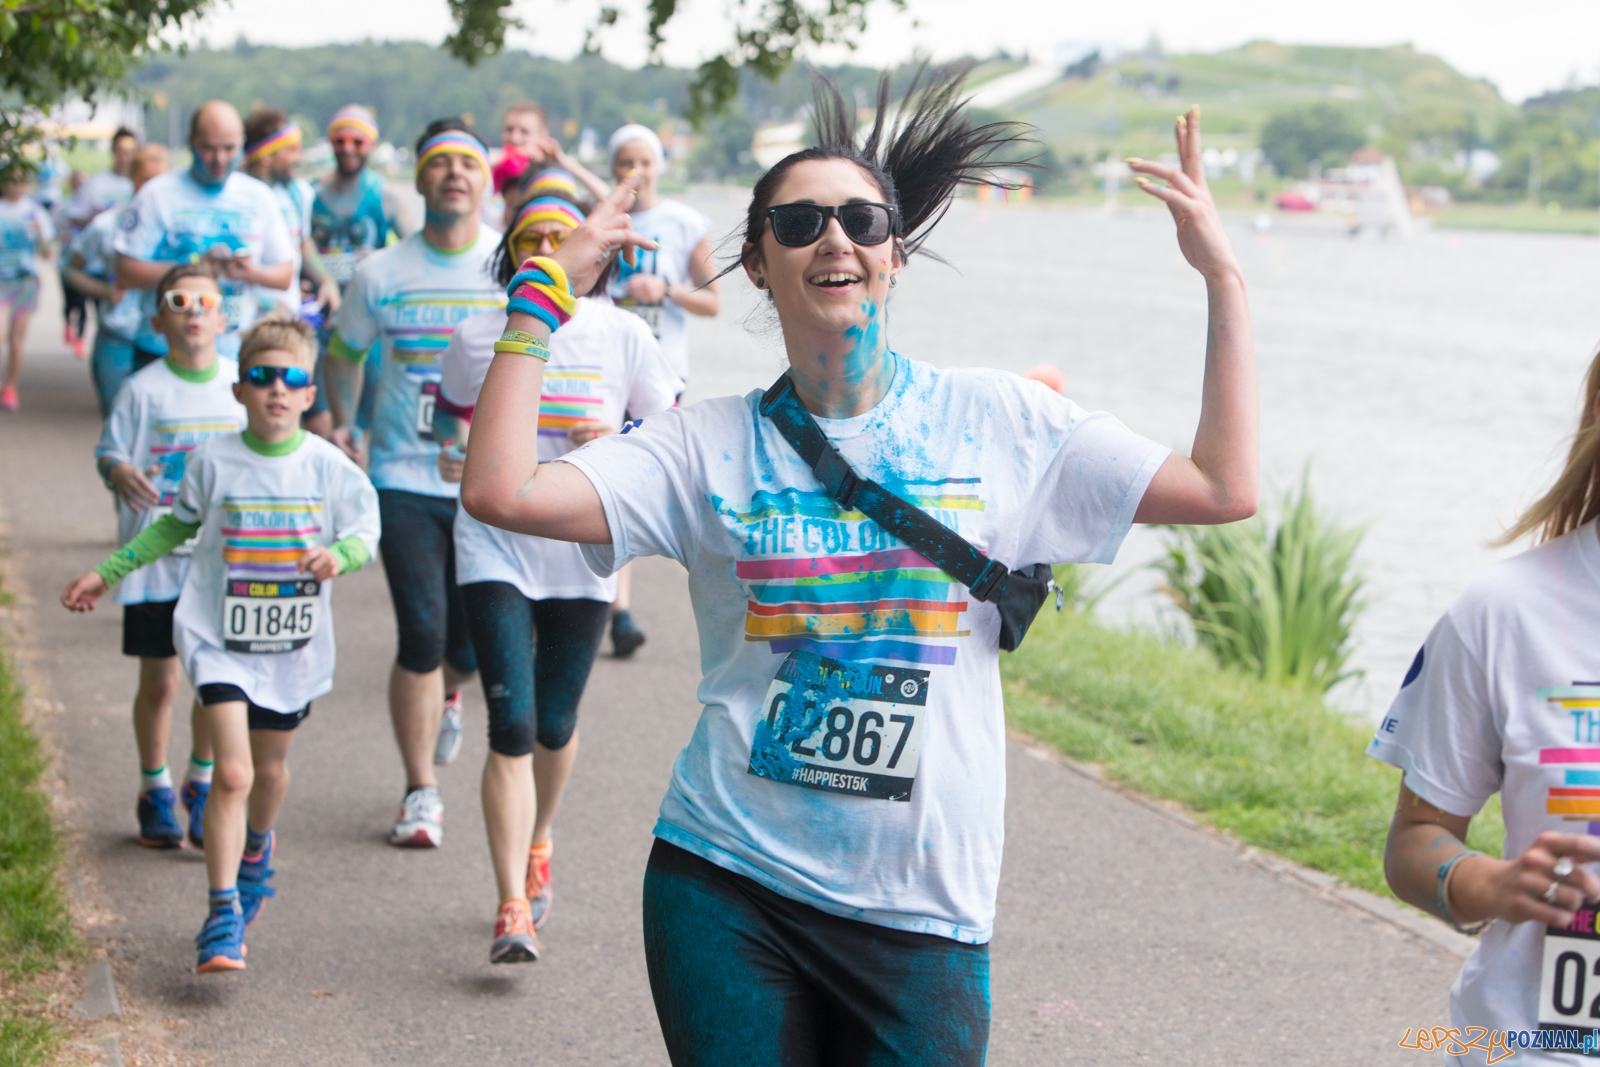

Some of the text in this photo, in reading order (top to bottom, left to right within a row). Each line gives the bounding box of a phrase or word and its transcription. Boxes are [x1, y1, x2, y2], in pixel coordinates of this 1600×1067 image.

[244, 511, 286, 527] COLOR
[742, 517, 795, 556] THE
[232, 582, 249, 596] THE
[249, 582, 279, 597] COLOR
[231, 604, 312, 635] 01845
[791, 766, 869, 792] #HAPPIEST5K
